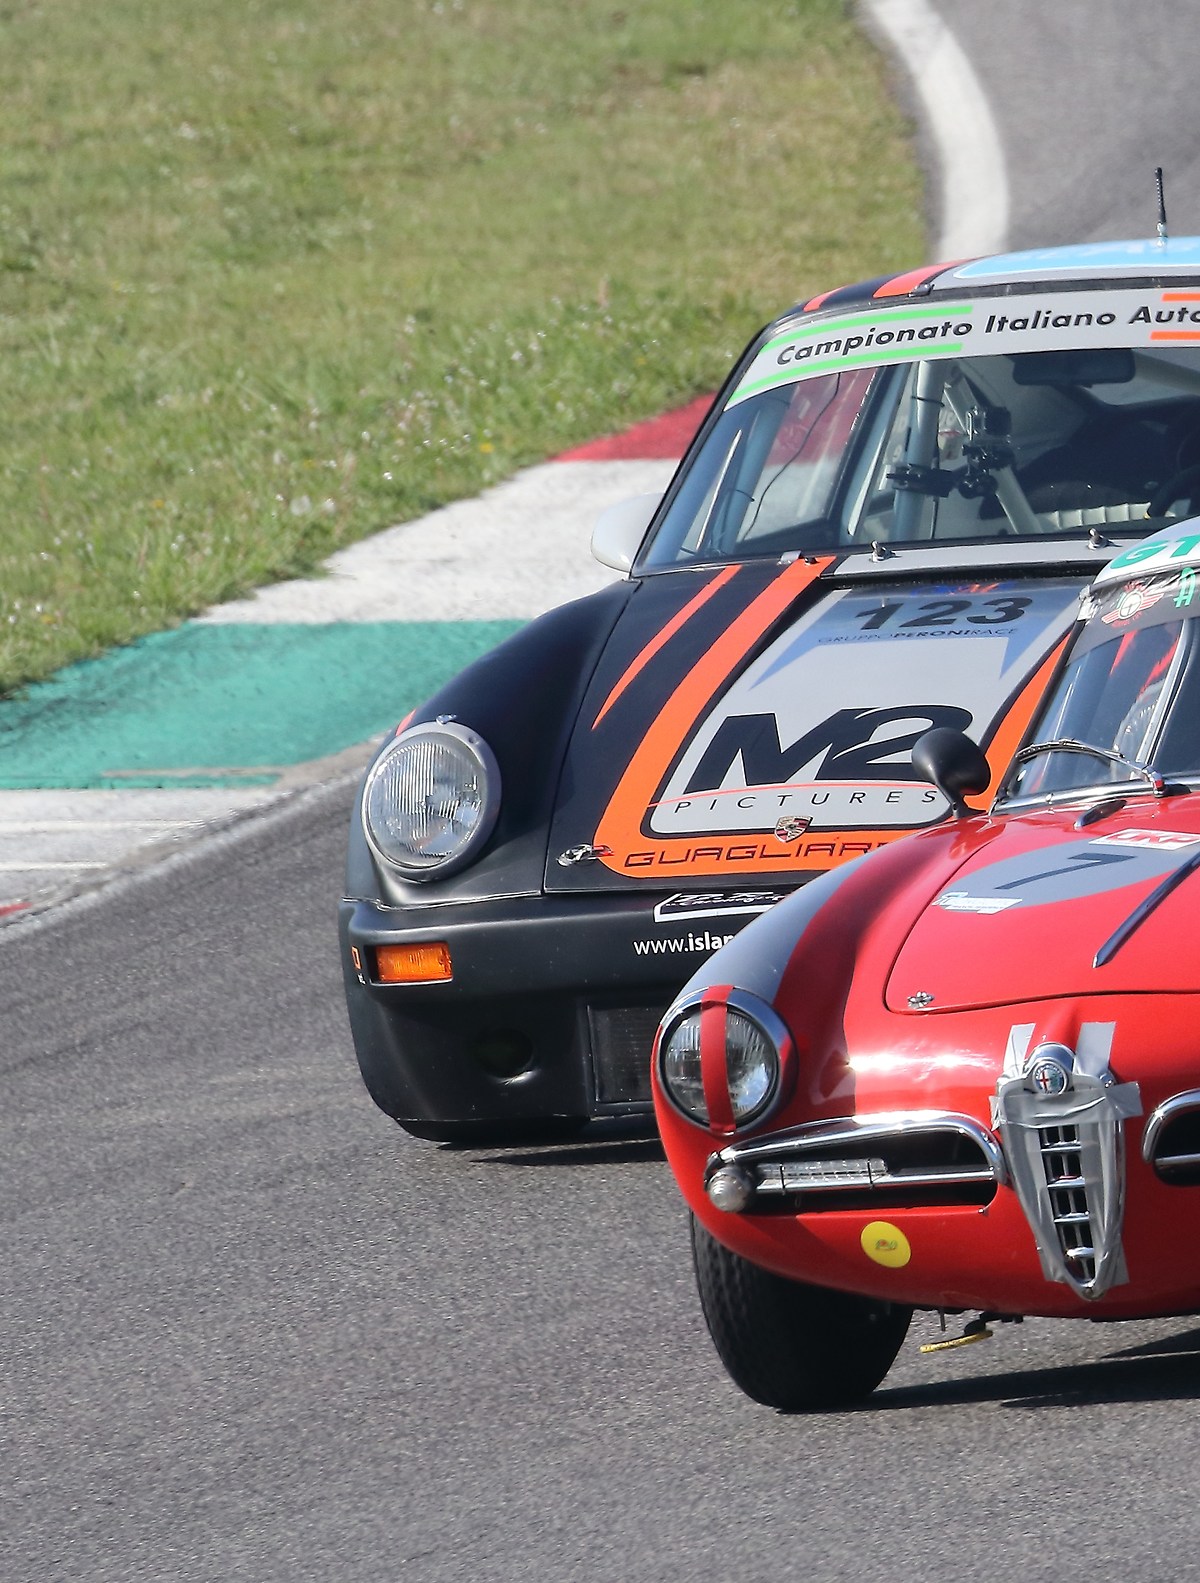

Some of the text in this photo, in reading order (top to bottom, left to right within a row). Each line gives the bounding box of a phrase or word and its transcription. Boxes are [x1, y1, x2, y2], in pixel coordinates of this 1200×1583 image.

[776, 321, 973, 366] Campionato
[984, 309, 1117, 336] Italiano
[855, 597, 1033, 630] 123
[683, 704, 973, 795] M2
[674, 790, 938, 814] PICTURES
[624, 842, 892, 868] GUAGLIAR
[993, 852, 1137, 890] 7
